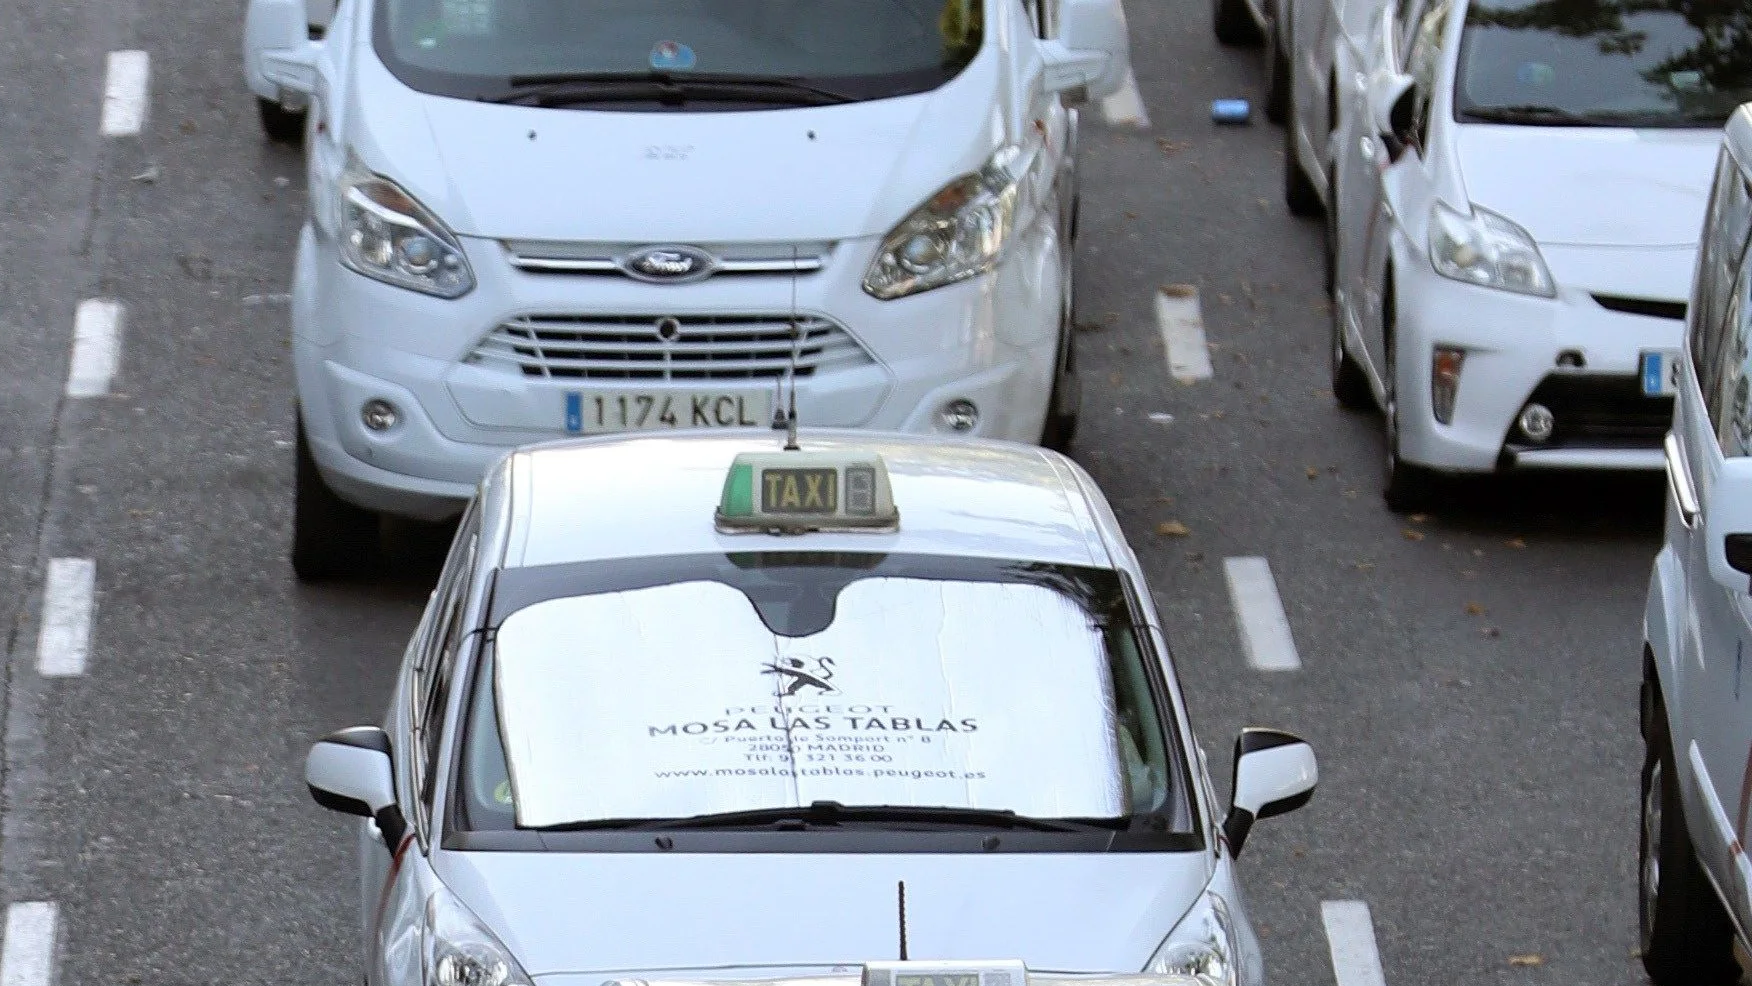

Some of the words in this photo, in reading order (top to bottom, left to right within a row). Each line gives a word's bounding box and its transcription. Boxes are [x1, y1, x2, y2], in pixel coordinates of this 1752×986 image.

[594, 395, 678, 427] 1174
[691, 395, 757, 427] KCL
[765, 473, 836, 507] TAXI
[725, 704, 895, 716] PEUGEOT
[648, 717, 756, 737] MOSA
[770, 716, 831, 731] LAS
[843, 716, 979, 733] TABLAS
[725, 734, 784, 743] Puerto
[815, 733, 890, 744] Somport
[808, 743, 885, 752] MADRID
